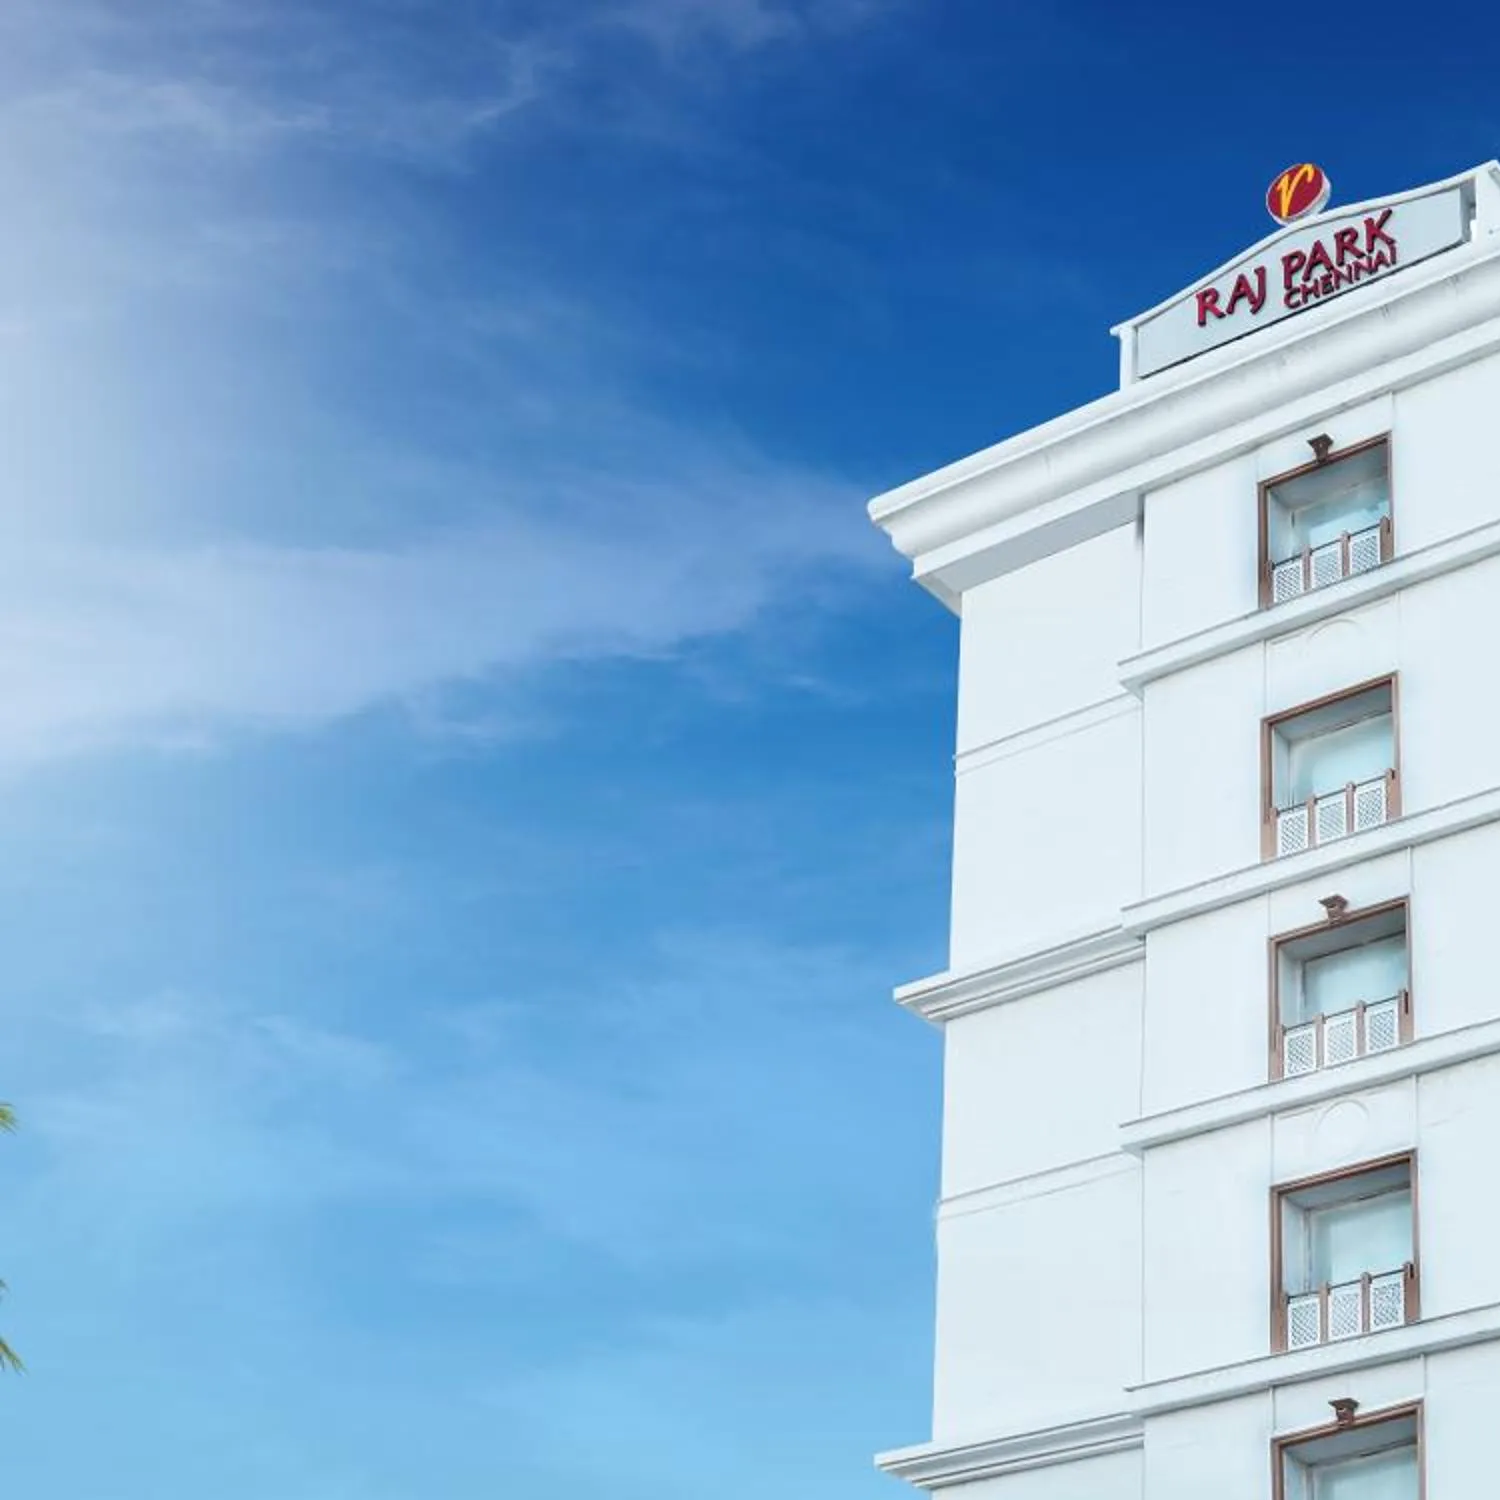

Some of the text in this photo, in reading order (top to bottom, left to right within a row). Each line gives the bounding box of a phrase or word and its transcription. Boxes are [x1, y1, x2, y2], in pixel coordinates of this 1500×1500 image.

[1196, 208, 1397, 327] RAJ PARK
[1283, 243, 1398, 310] CHENNAI
